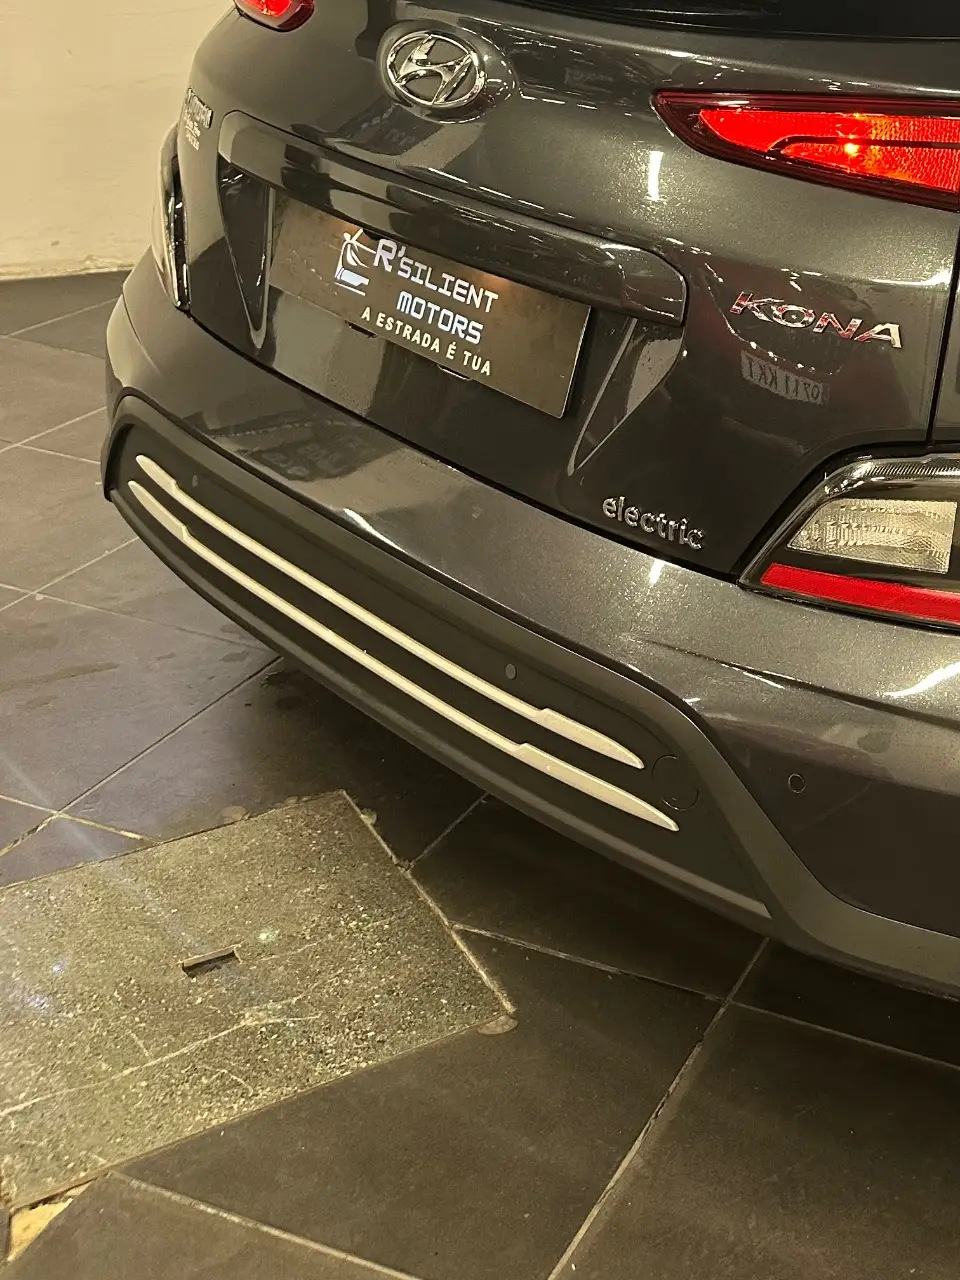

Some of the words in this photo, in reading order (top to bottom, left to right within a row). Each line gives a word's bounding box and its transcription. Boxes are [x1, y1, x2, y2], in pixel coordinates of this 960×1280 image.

[361, 306, 371, 322] A
[376, 312, 440, 354] ESTRADA
[446, 341, 456, 360] É
[463, 351, 491, 377] TUA
[396, 290, 484, 345] MOTORS
[729, 290, 903, 349] KONA
[602, 496, 707, 551] electric
